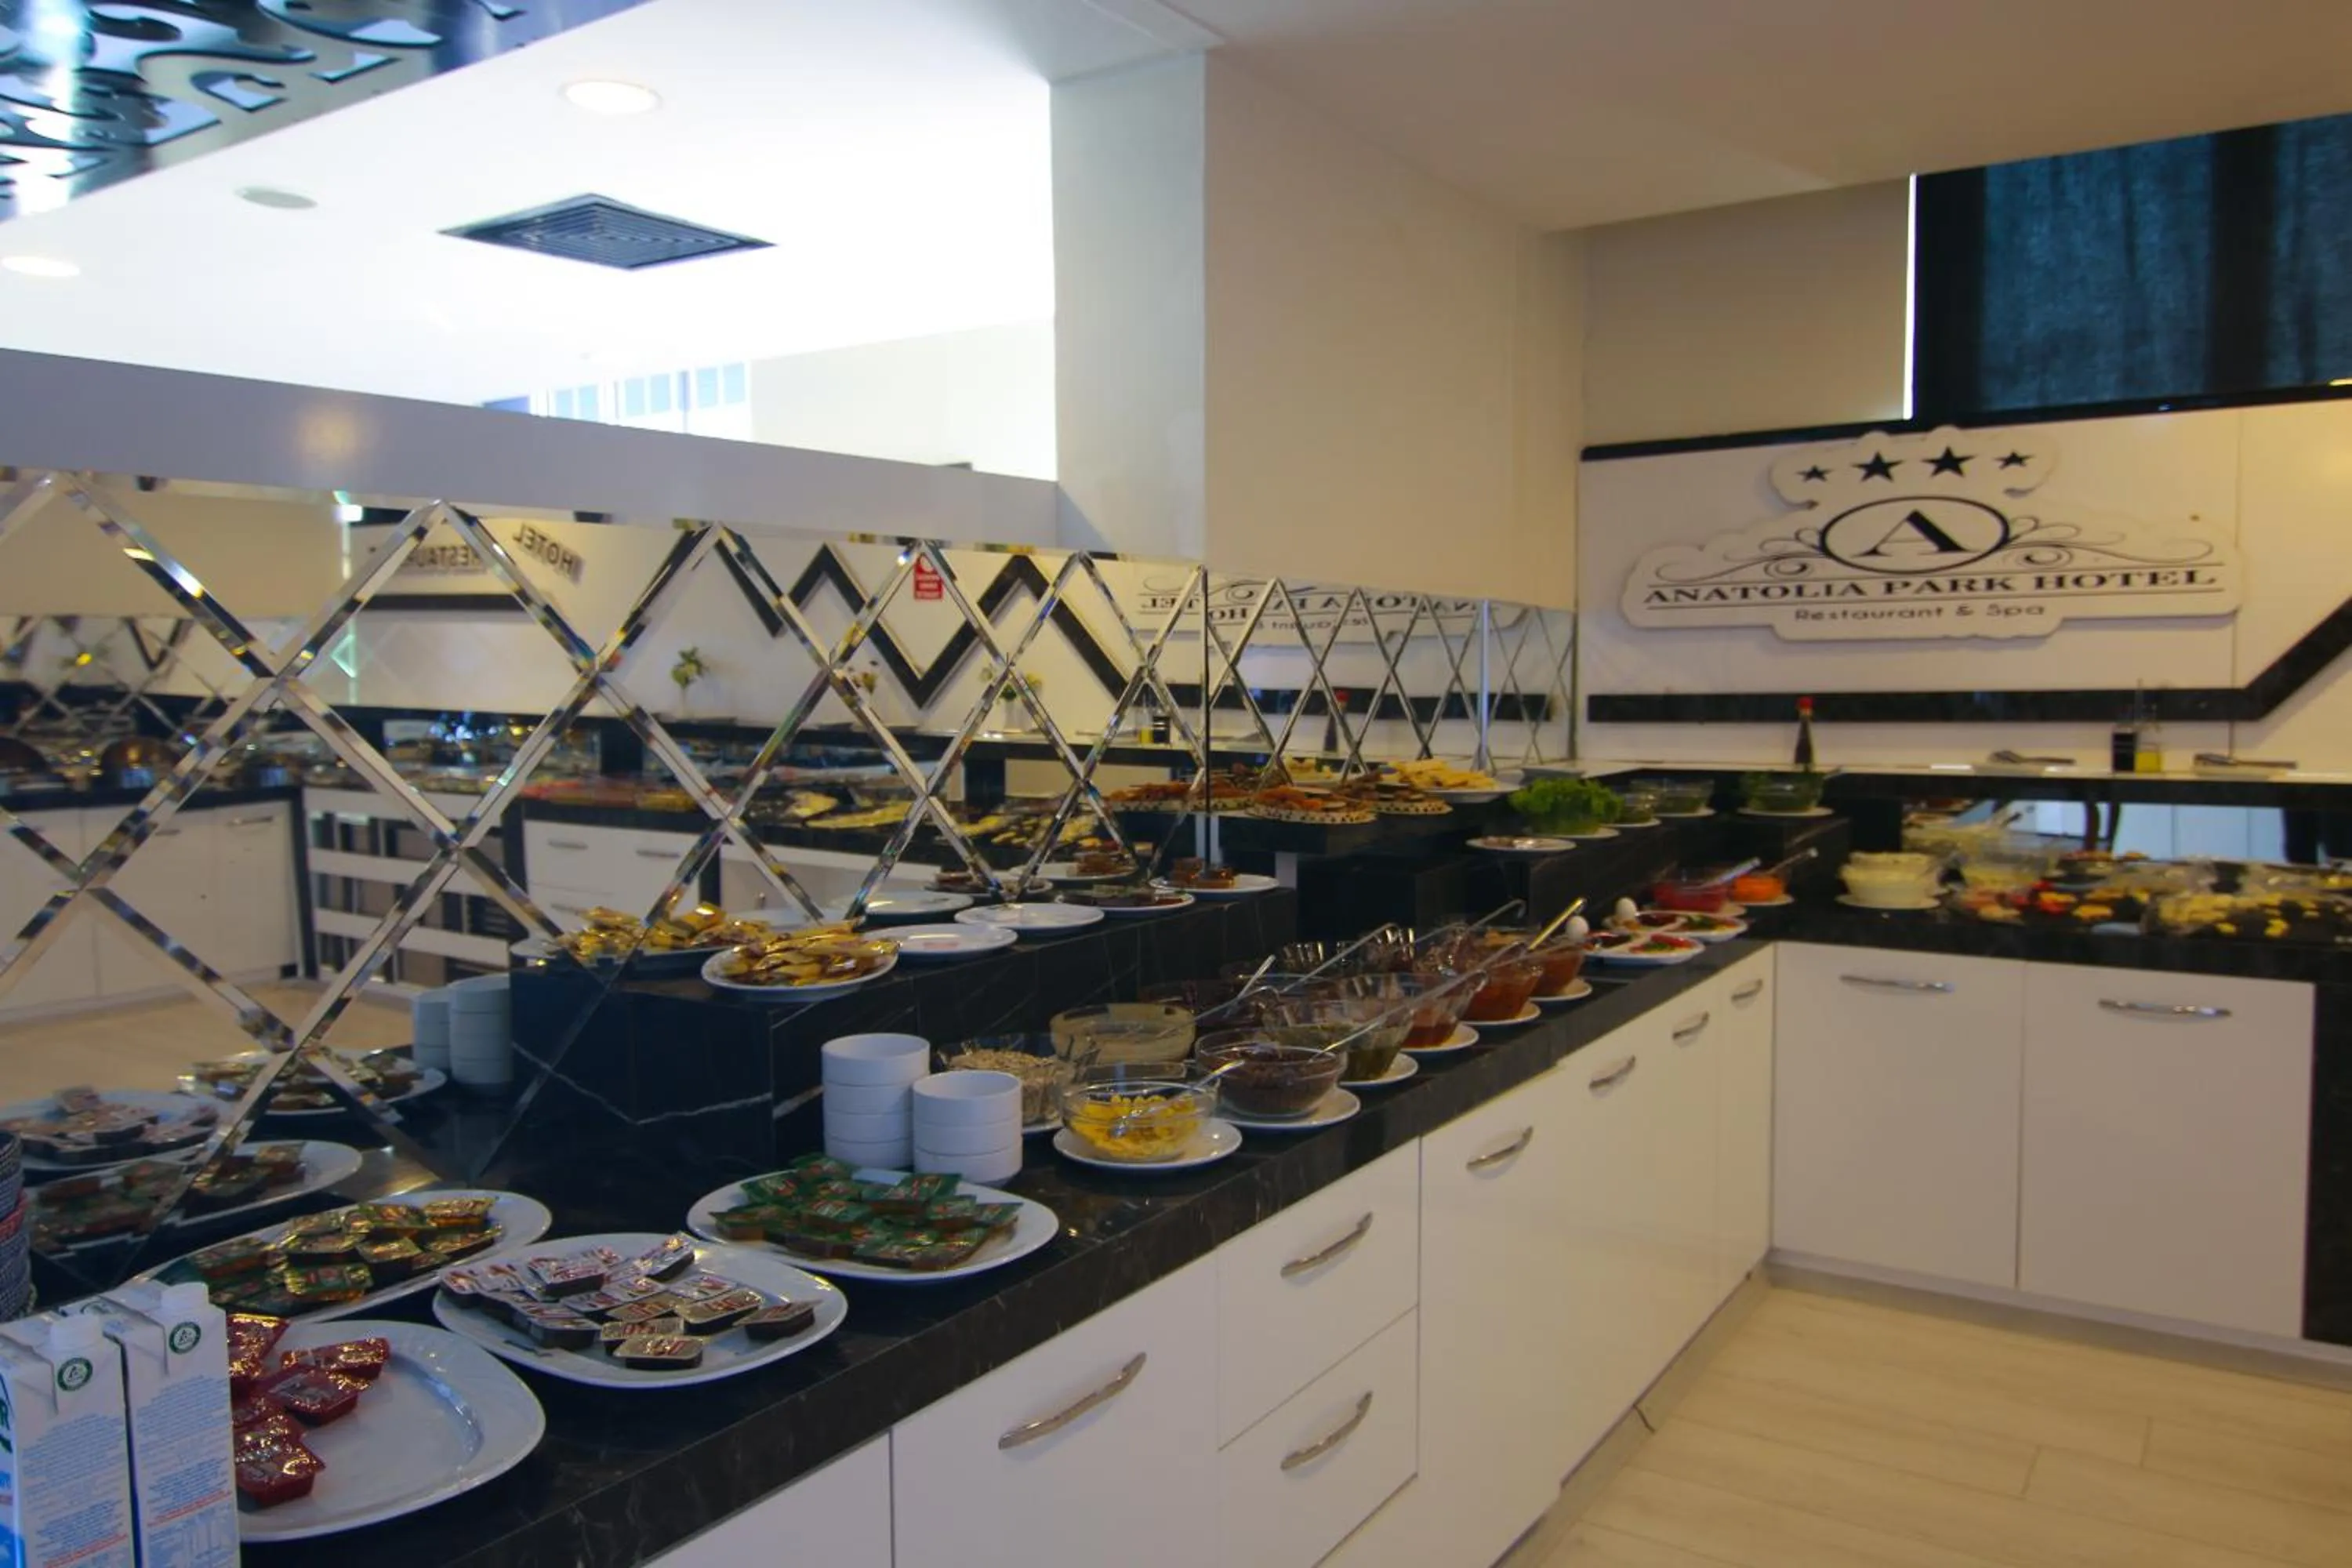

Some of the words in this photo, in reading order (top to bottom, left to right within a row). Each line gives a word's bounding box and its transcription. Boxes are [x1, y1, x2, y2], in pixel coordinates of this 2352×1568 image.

[1853, 509, 1979, 557] A
[1643, 580, 1867, 603] ANATOLIA
[1882, 576, 2016, 596] PARK
[2034, 569, 2217, 590] HOTEL
[1794, 605, 1944, 622] Restaurant
[1955, 604, 1974, 616] &
[1986, 602, 2046, 617] Spa
